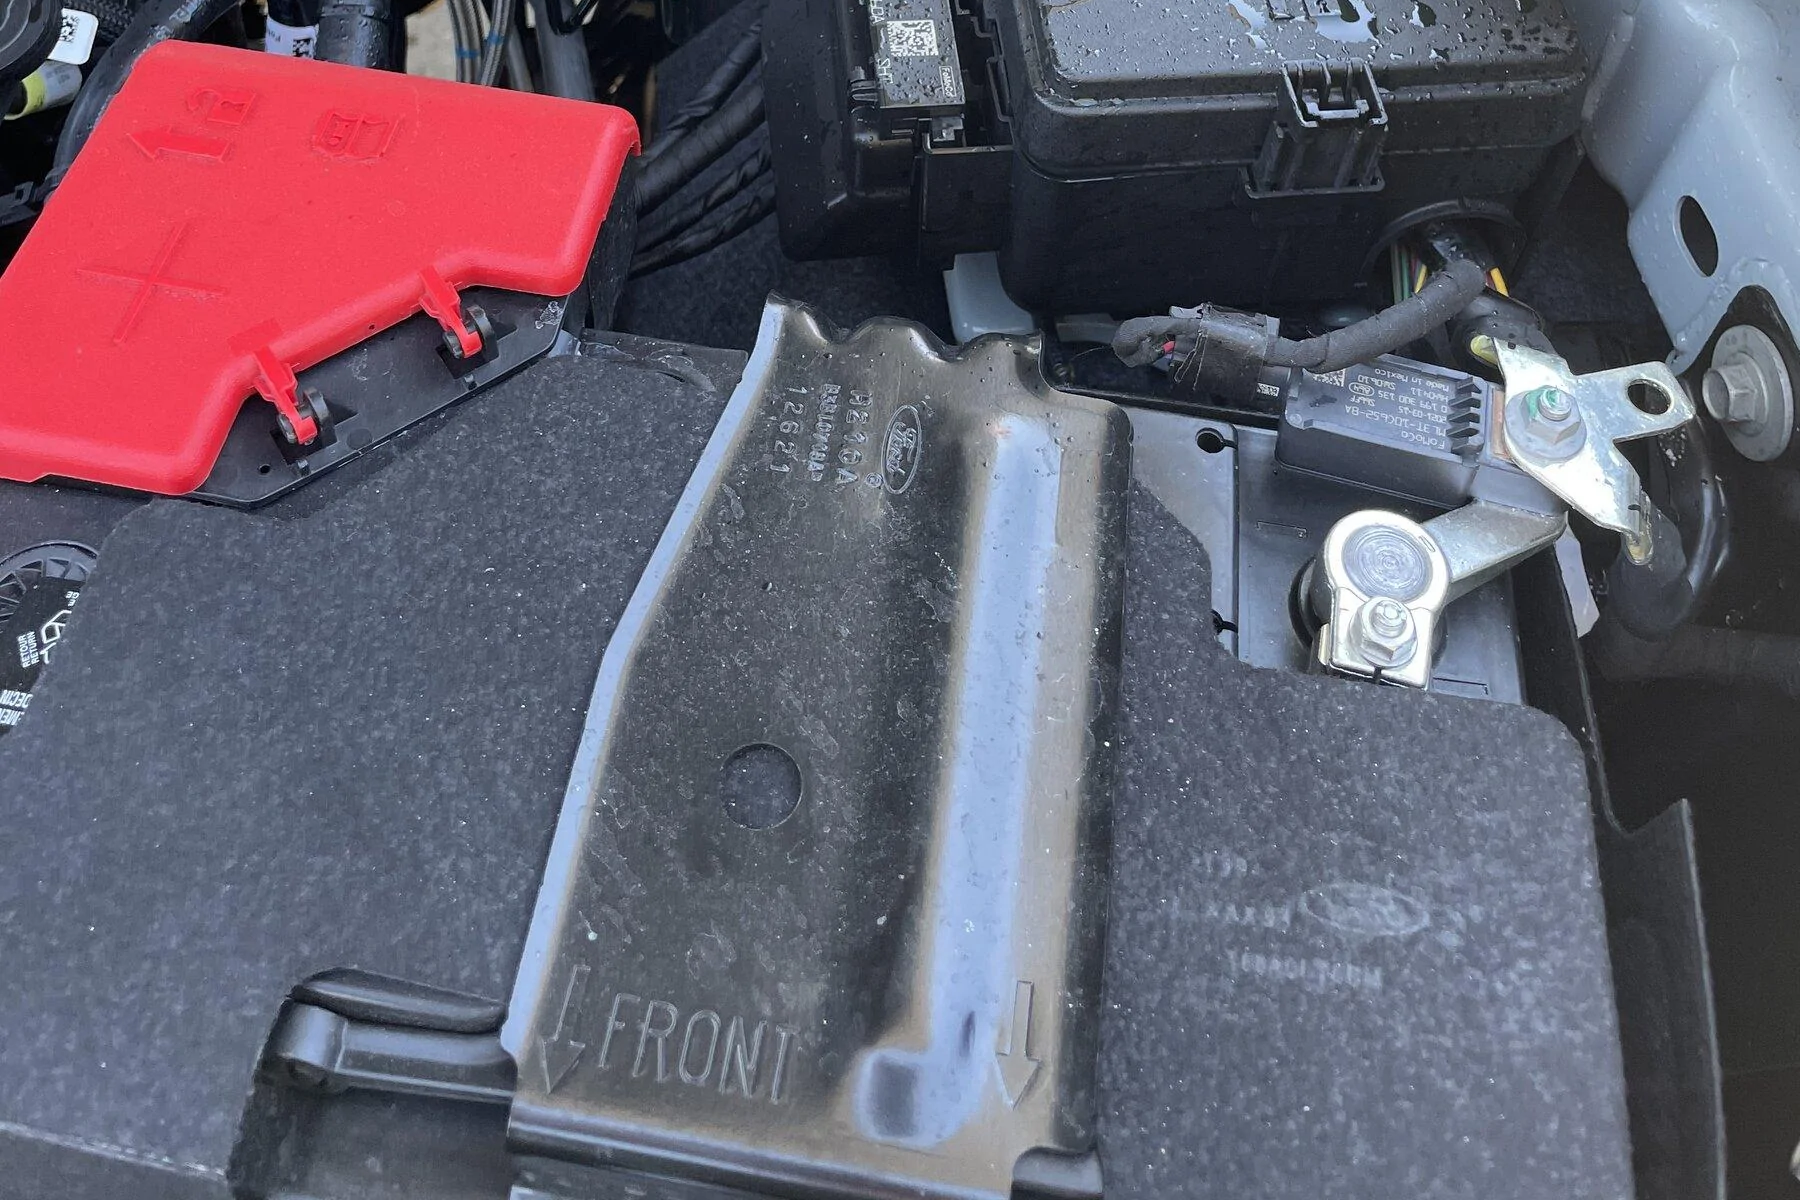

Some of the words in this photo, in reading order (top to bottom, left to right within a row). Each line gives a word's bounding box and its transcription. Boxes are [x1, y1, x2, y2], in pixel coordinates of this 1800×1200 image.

[1374, 368, 1408, 382] Mexico
[1426, 380, 1449, 392] Made
[17, 634, 31, 668] RETOUR
[26, 631, 40, 665] RETURN
[596, 990, 802, 1106] FRONT
